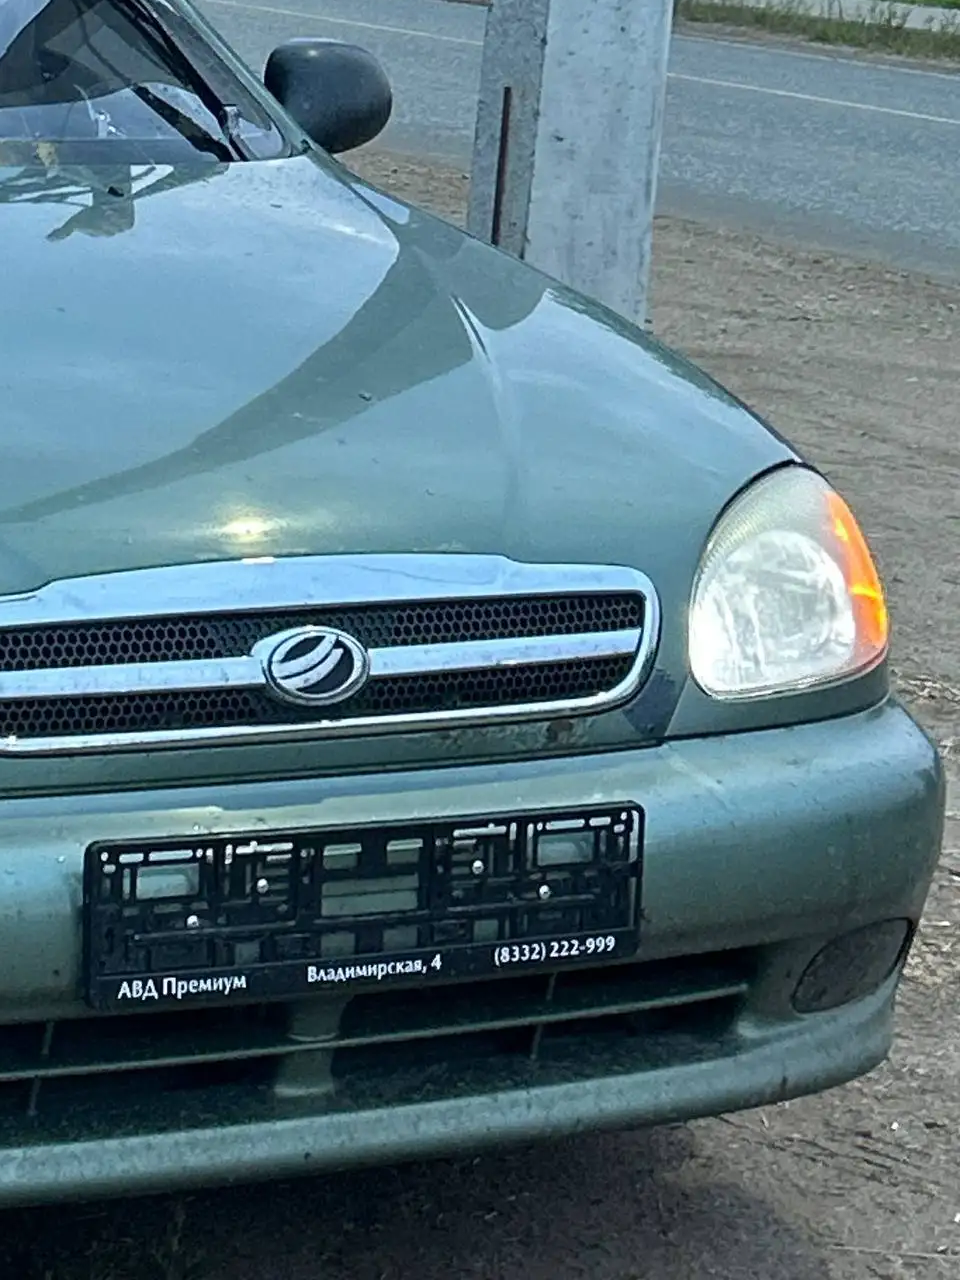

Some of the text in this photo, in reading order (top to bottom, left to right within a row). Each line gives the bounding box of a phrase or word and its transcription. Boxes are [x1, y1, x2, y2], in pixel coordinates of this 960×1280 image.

[117, 935, 616, 1001] АВД Премиум Владимирская, 4 (8332) 222-999
